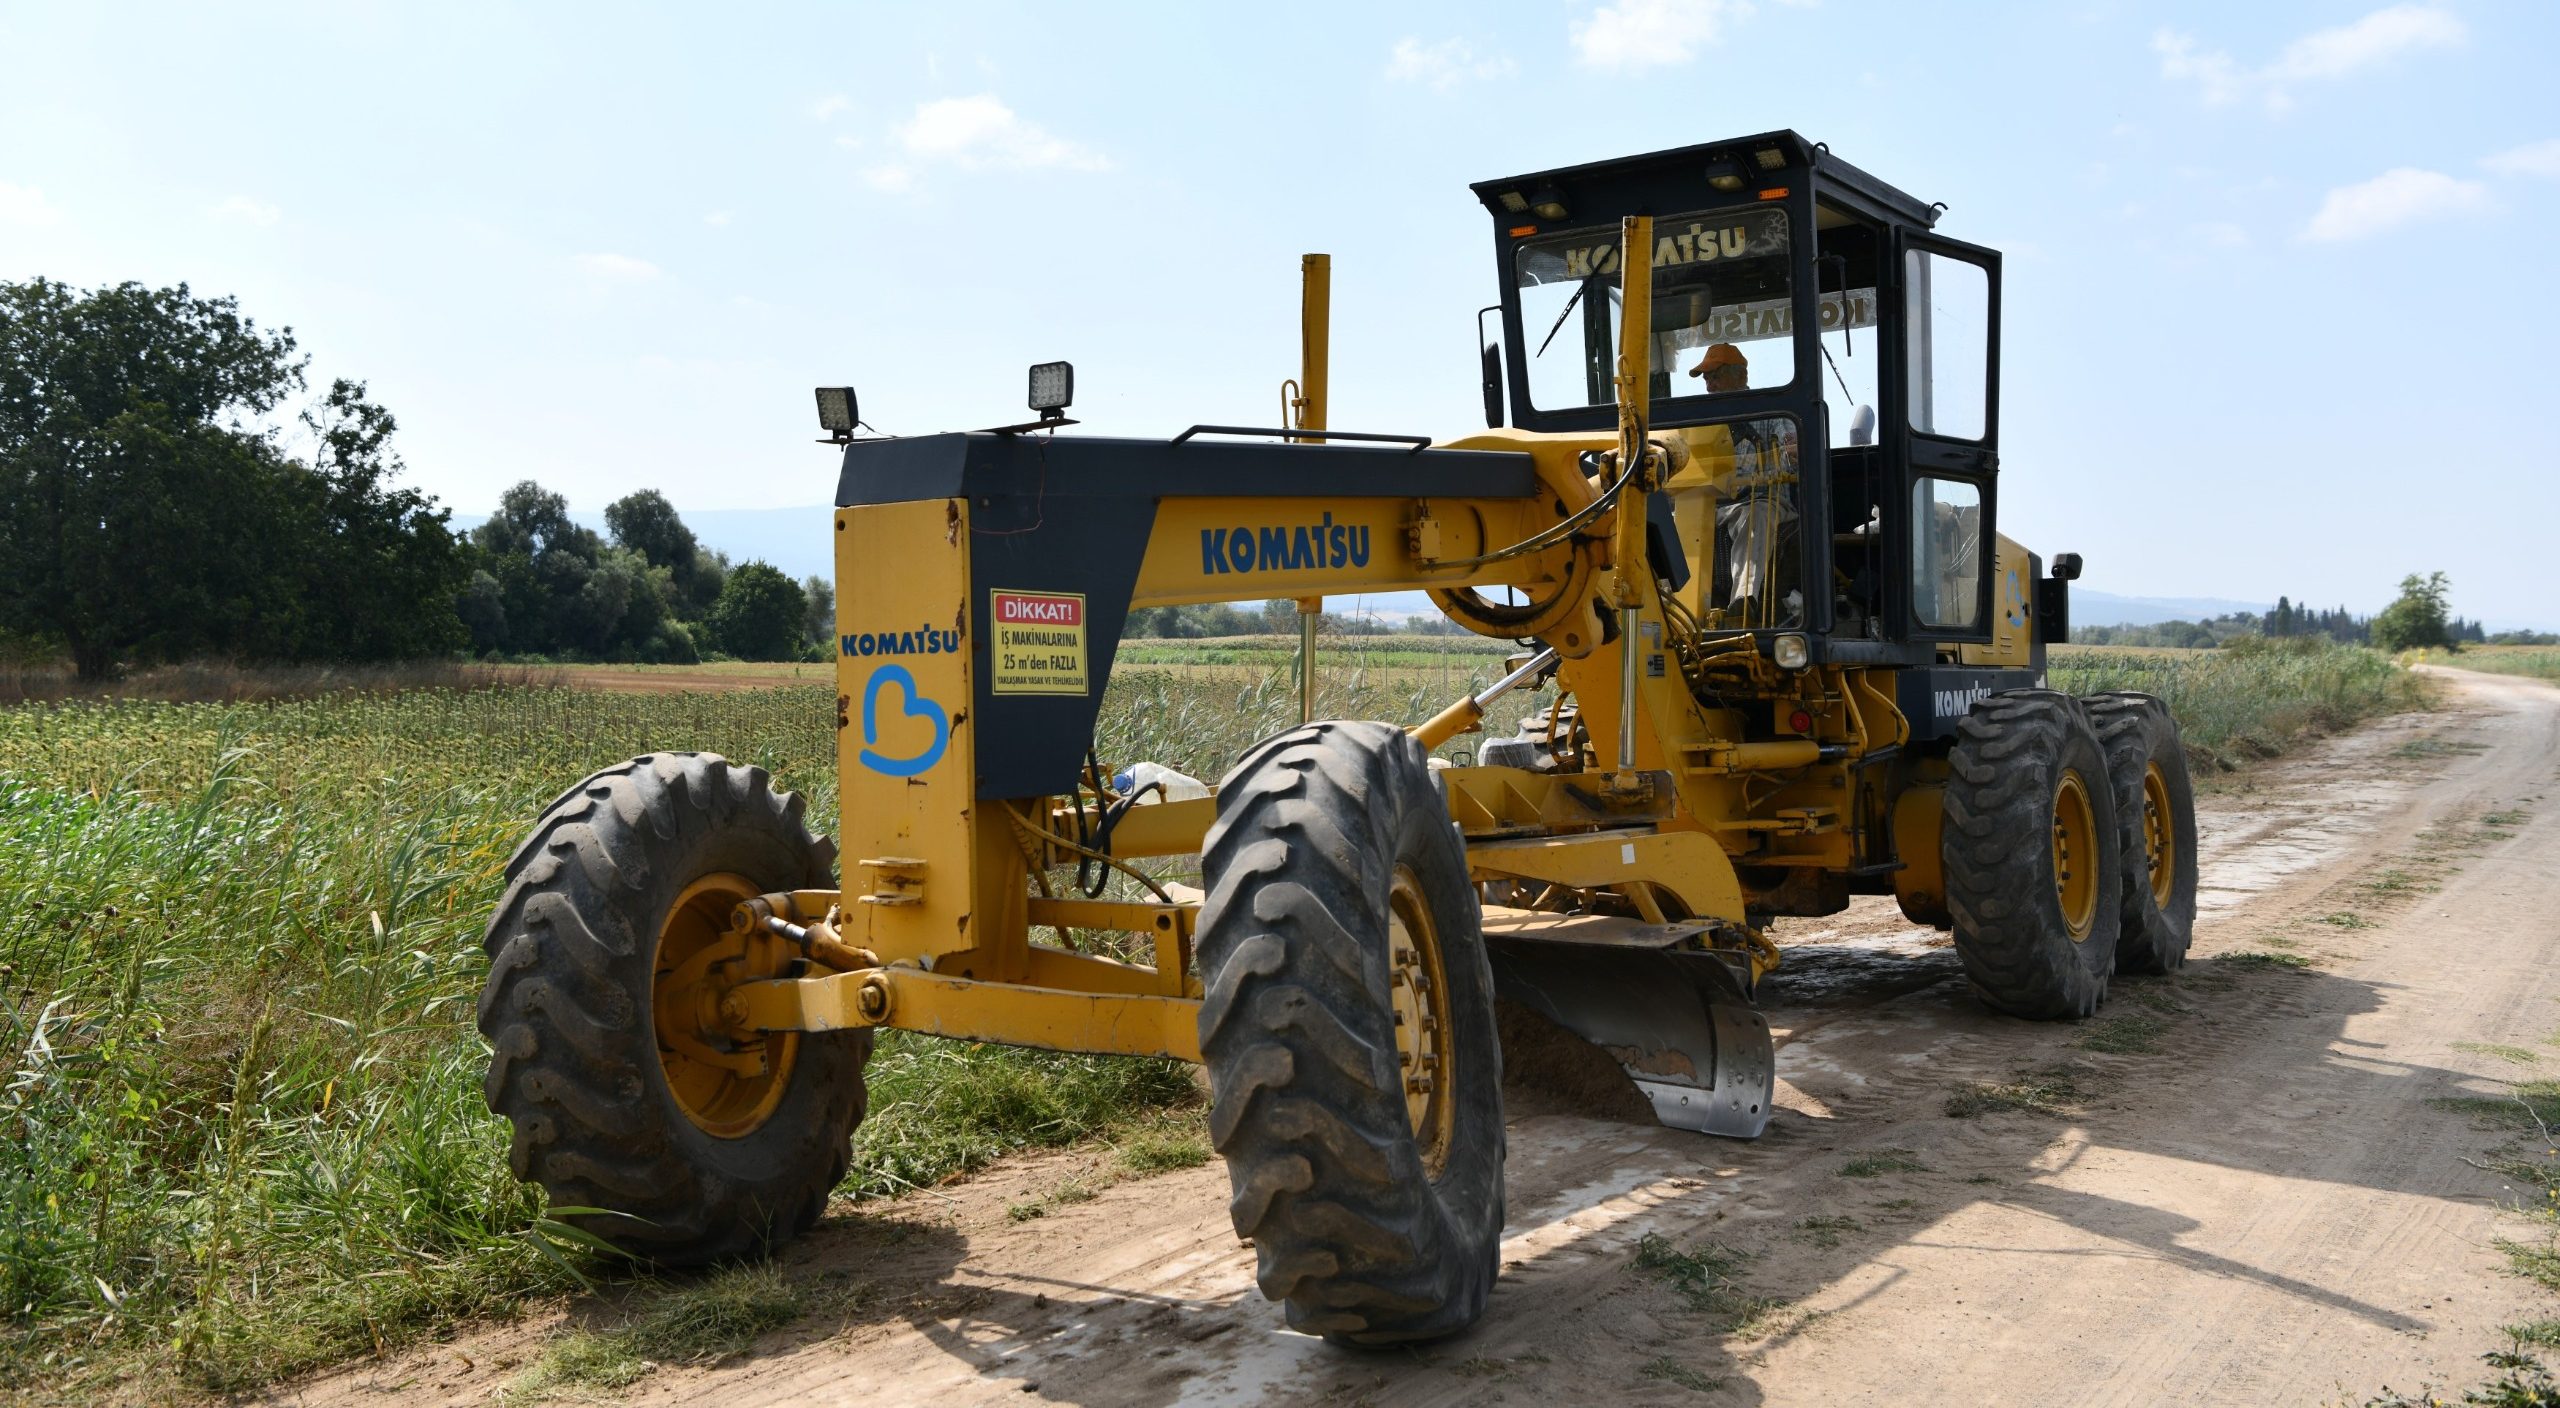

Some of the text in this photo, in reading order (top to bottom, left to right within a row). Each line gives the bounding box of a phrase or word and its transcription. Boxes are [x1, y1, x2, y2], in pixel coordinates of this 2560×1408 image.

[1566, 223, 1746, 277] KOATSU
[1201, 511, 1370, 575] KOMATSU
[1005, 598, 1072, 621] DİKKAT!
[841, 623, 959, 656] KOMATSU
[1001, 626, 1078, 649] İŞ MAKİNALARINA
[1003, 653, 1015, 670] 25
[1050, 655, 1077, 670] FAZLA
[1028, 676, 1044, 685] YASAK
[1044, 676, 1052, 685] VE
